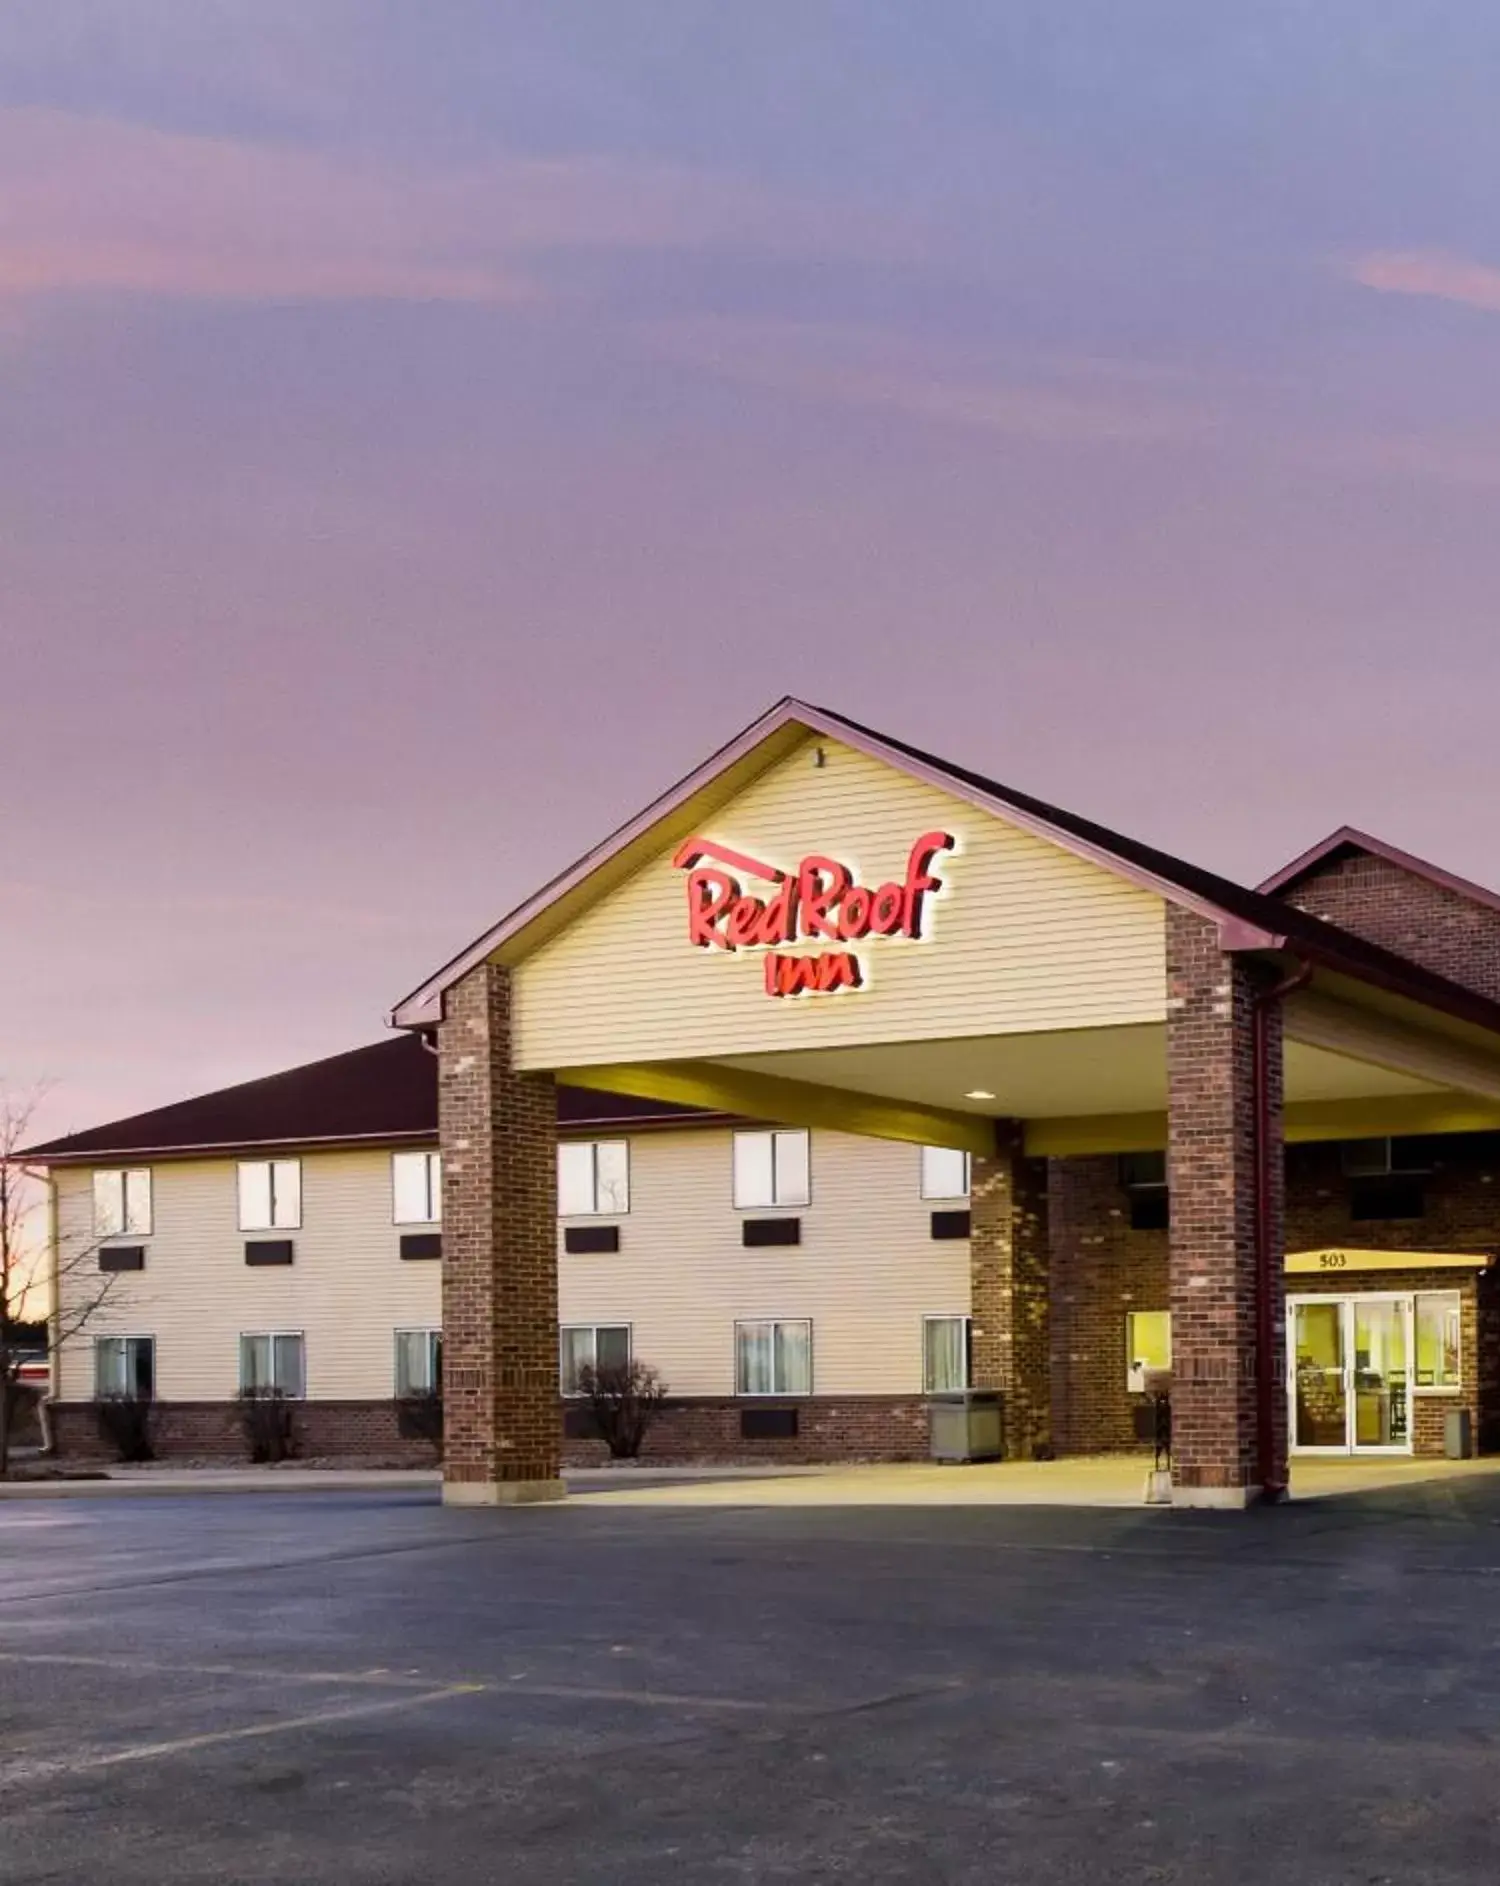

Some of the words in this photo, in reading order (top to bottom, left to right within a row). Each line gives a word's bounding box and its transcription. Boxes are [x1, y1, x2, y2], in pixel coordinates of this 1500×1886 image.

[687, 867, 798, 951] Red
[799, 831, 954, 941] Roof
[1319, 1253, 1347, 1268] 503
